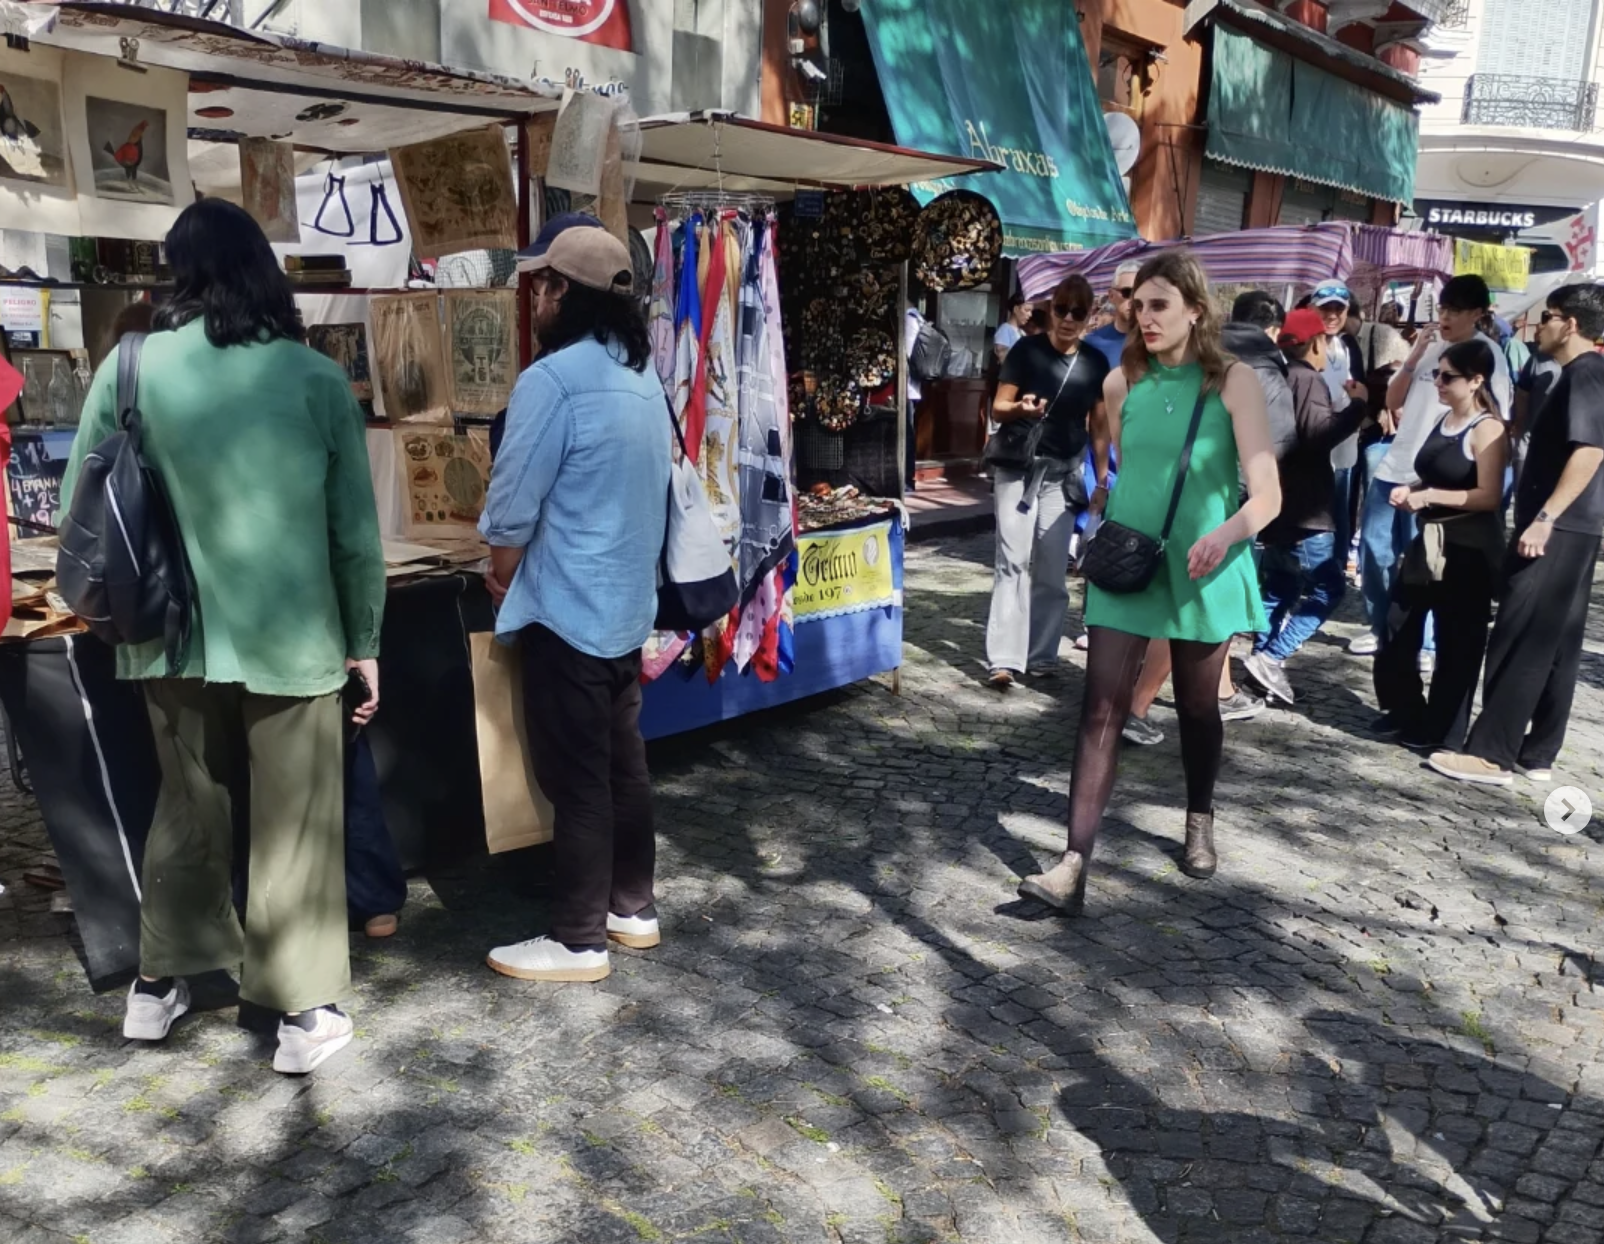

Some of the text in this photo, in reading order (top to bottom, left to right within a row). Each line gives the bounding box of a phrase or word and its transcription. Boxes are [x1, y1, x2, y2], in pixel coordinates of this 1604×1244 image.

[964, 120, 1060, 177] Abraxas
[1428, 207, 1535, 227] STARBUCKS
[793, 592, 814, 605] esde
